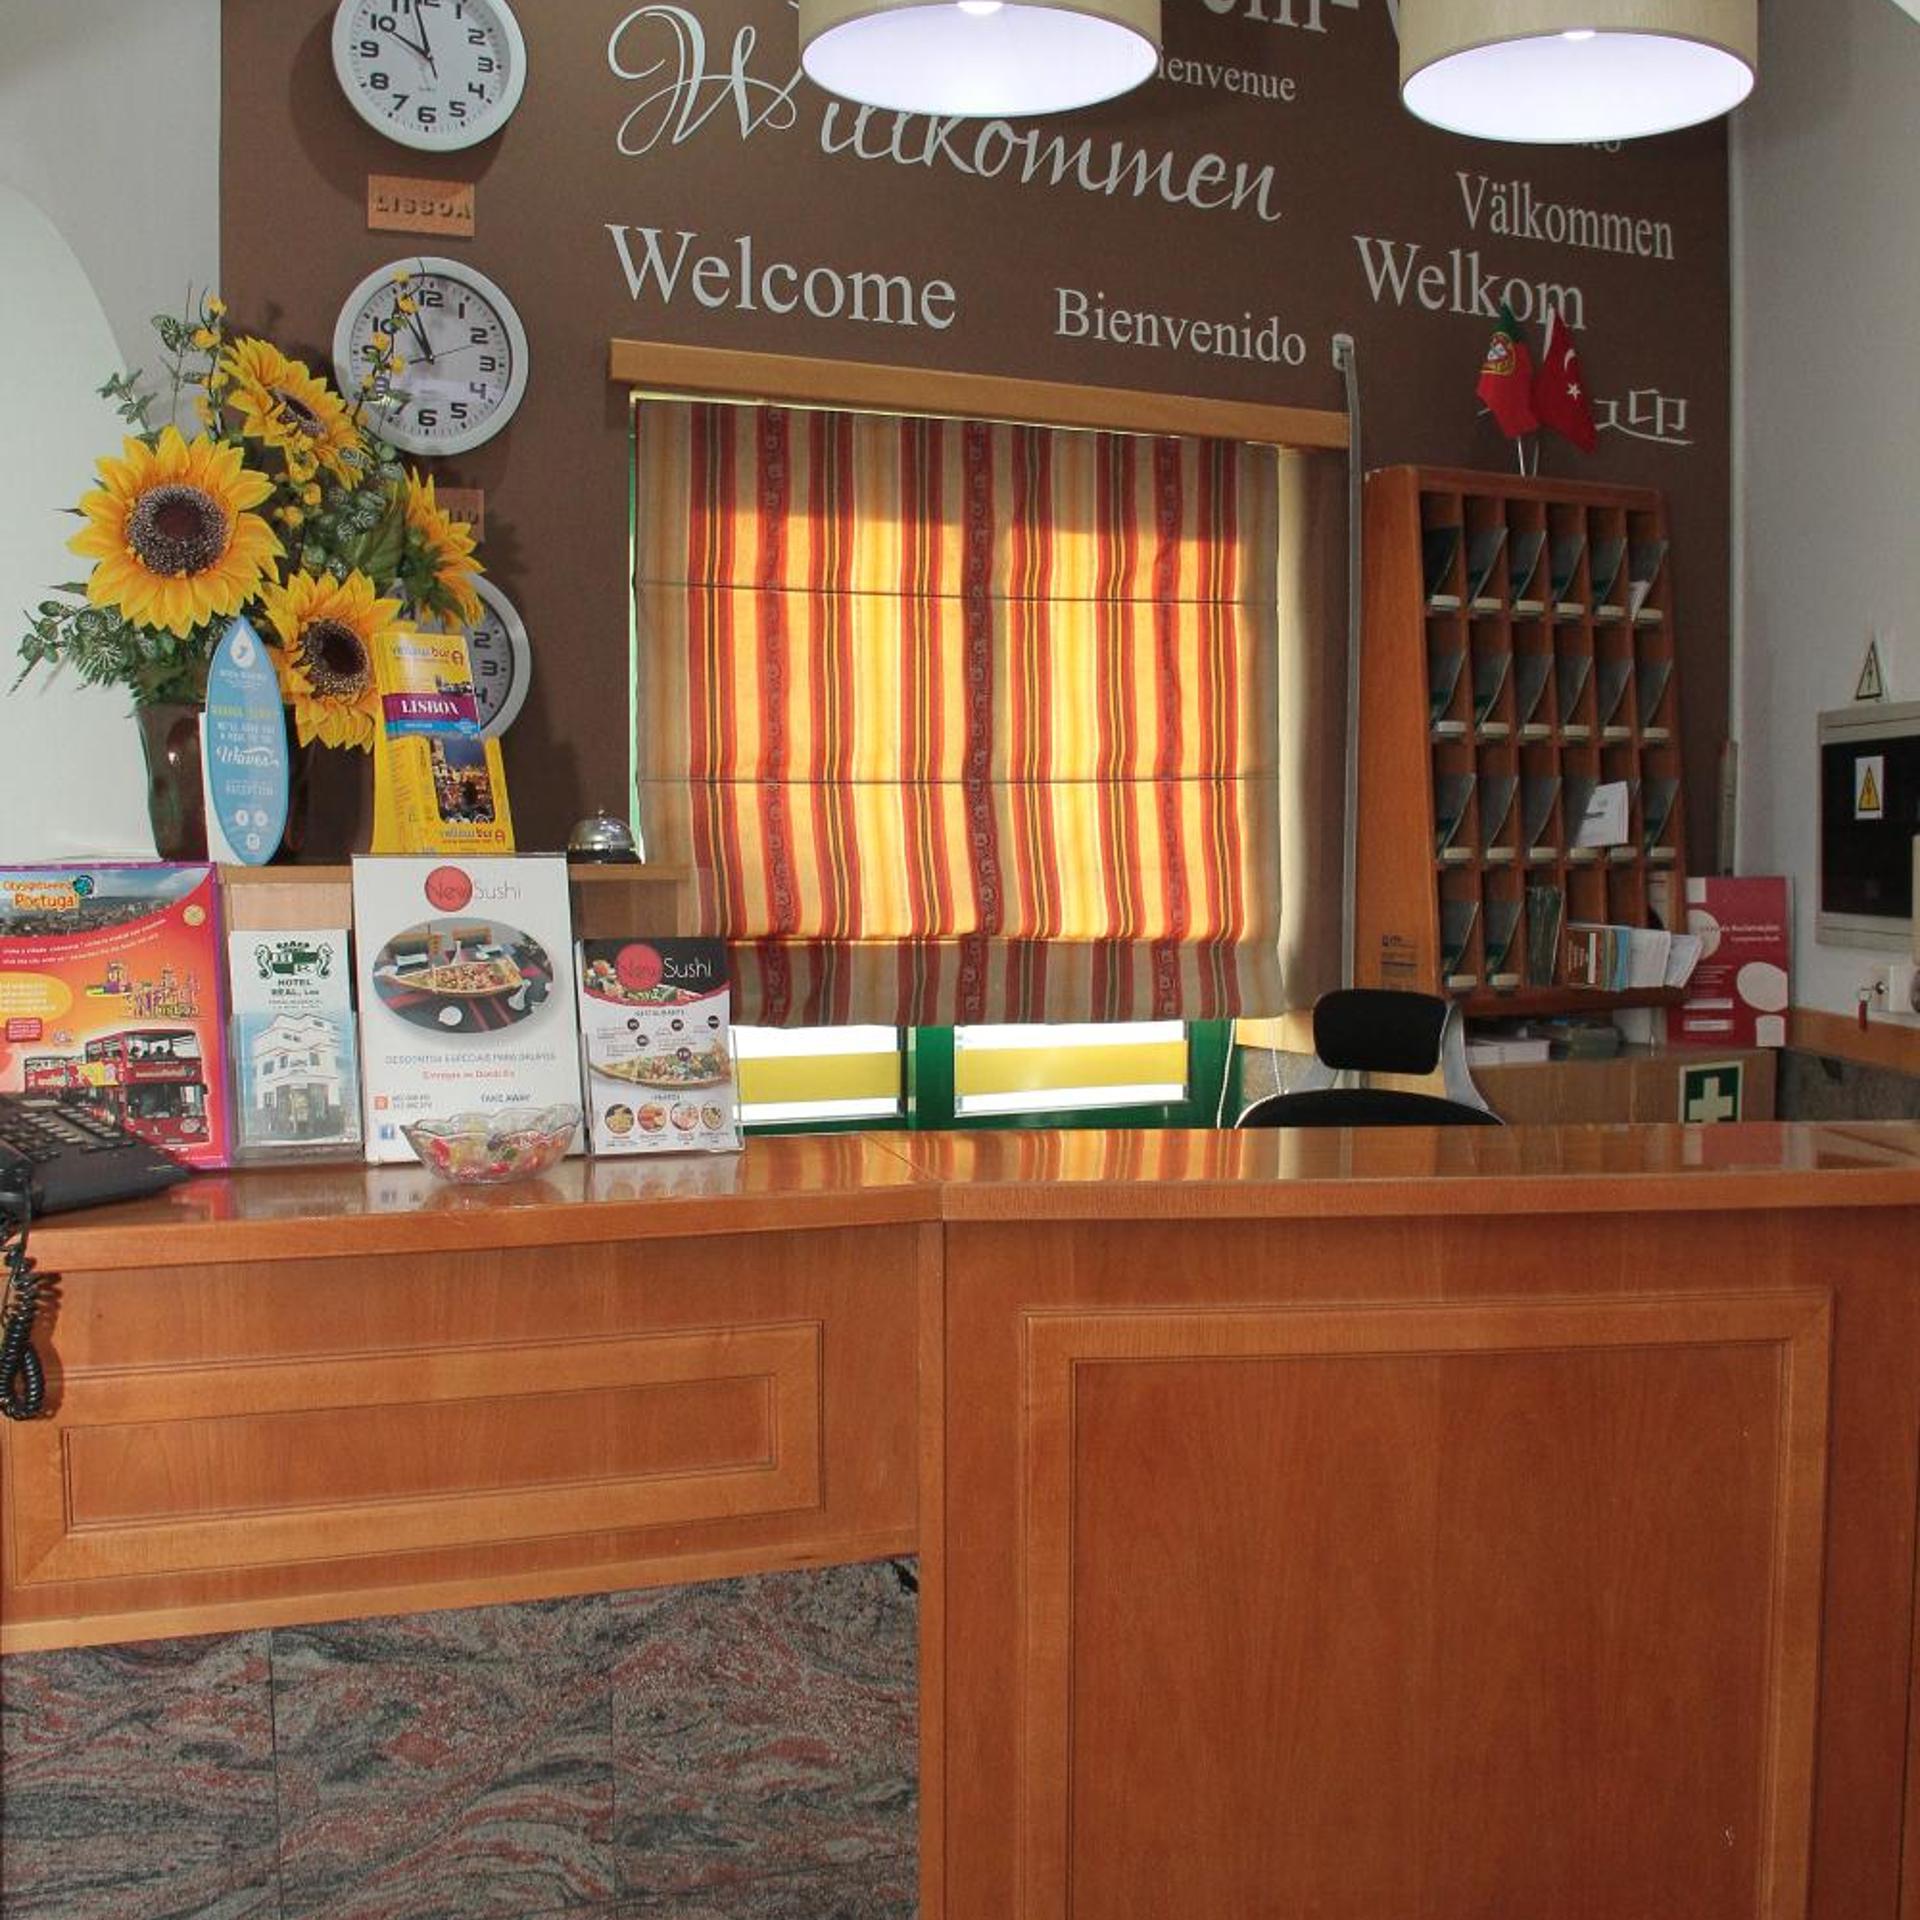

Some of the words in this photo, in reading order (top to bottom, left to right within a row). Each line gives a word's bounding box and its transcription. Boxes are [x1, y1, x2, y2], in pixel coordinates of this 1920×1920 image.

[371, 14, 396, 33] 10
[468, 28, 485, 45] 2
[361, 41, 379, 58] 9
[477, 57, 494, 73] 3
[1157, 44, 1296, 100] ienvenue
[370, 72, 389, 90] 8
[468, 82, 485, 99] 4
[393, 94, 410, 110] 7
[449, 101, 466, 118] 5
[418, 107, 436, 123] 6
[1456, 171, 1675, 260] Välkommen
[604, 223, 956, 329] Welcome
[1352, 235, 1588, 330] Welkom
[419, 290, 444, 307] 12
[458, 303, 465, 319] 1
[1054, 287, 1306, 365] Bienvenido
[470, 327, 488, 344] 2
[480, 356, 496, 372] 3
[470, 382, 486, 399] 4
[418, 409, 437, 426] 6
[451, 403, 468, 419] 5
[474, 632, 491, 649] 2
[481, 661, 498, 676] 3
[475, 879, 521, 899] Sushi
[664, 957, 712, 978] Sushi
[278, 979, 310, 987] HOTEL
